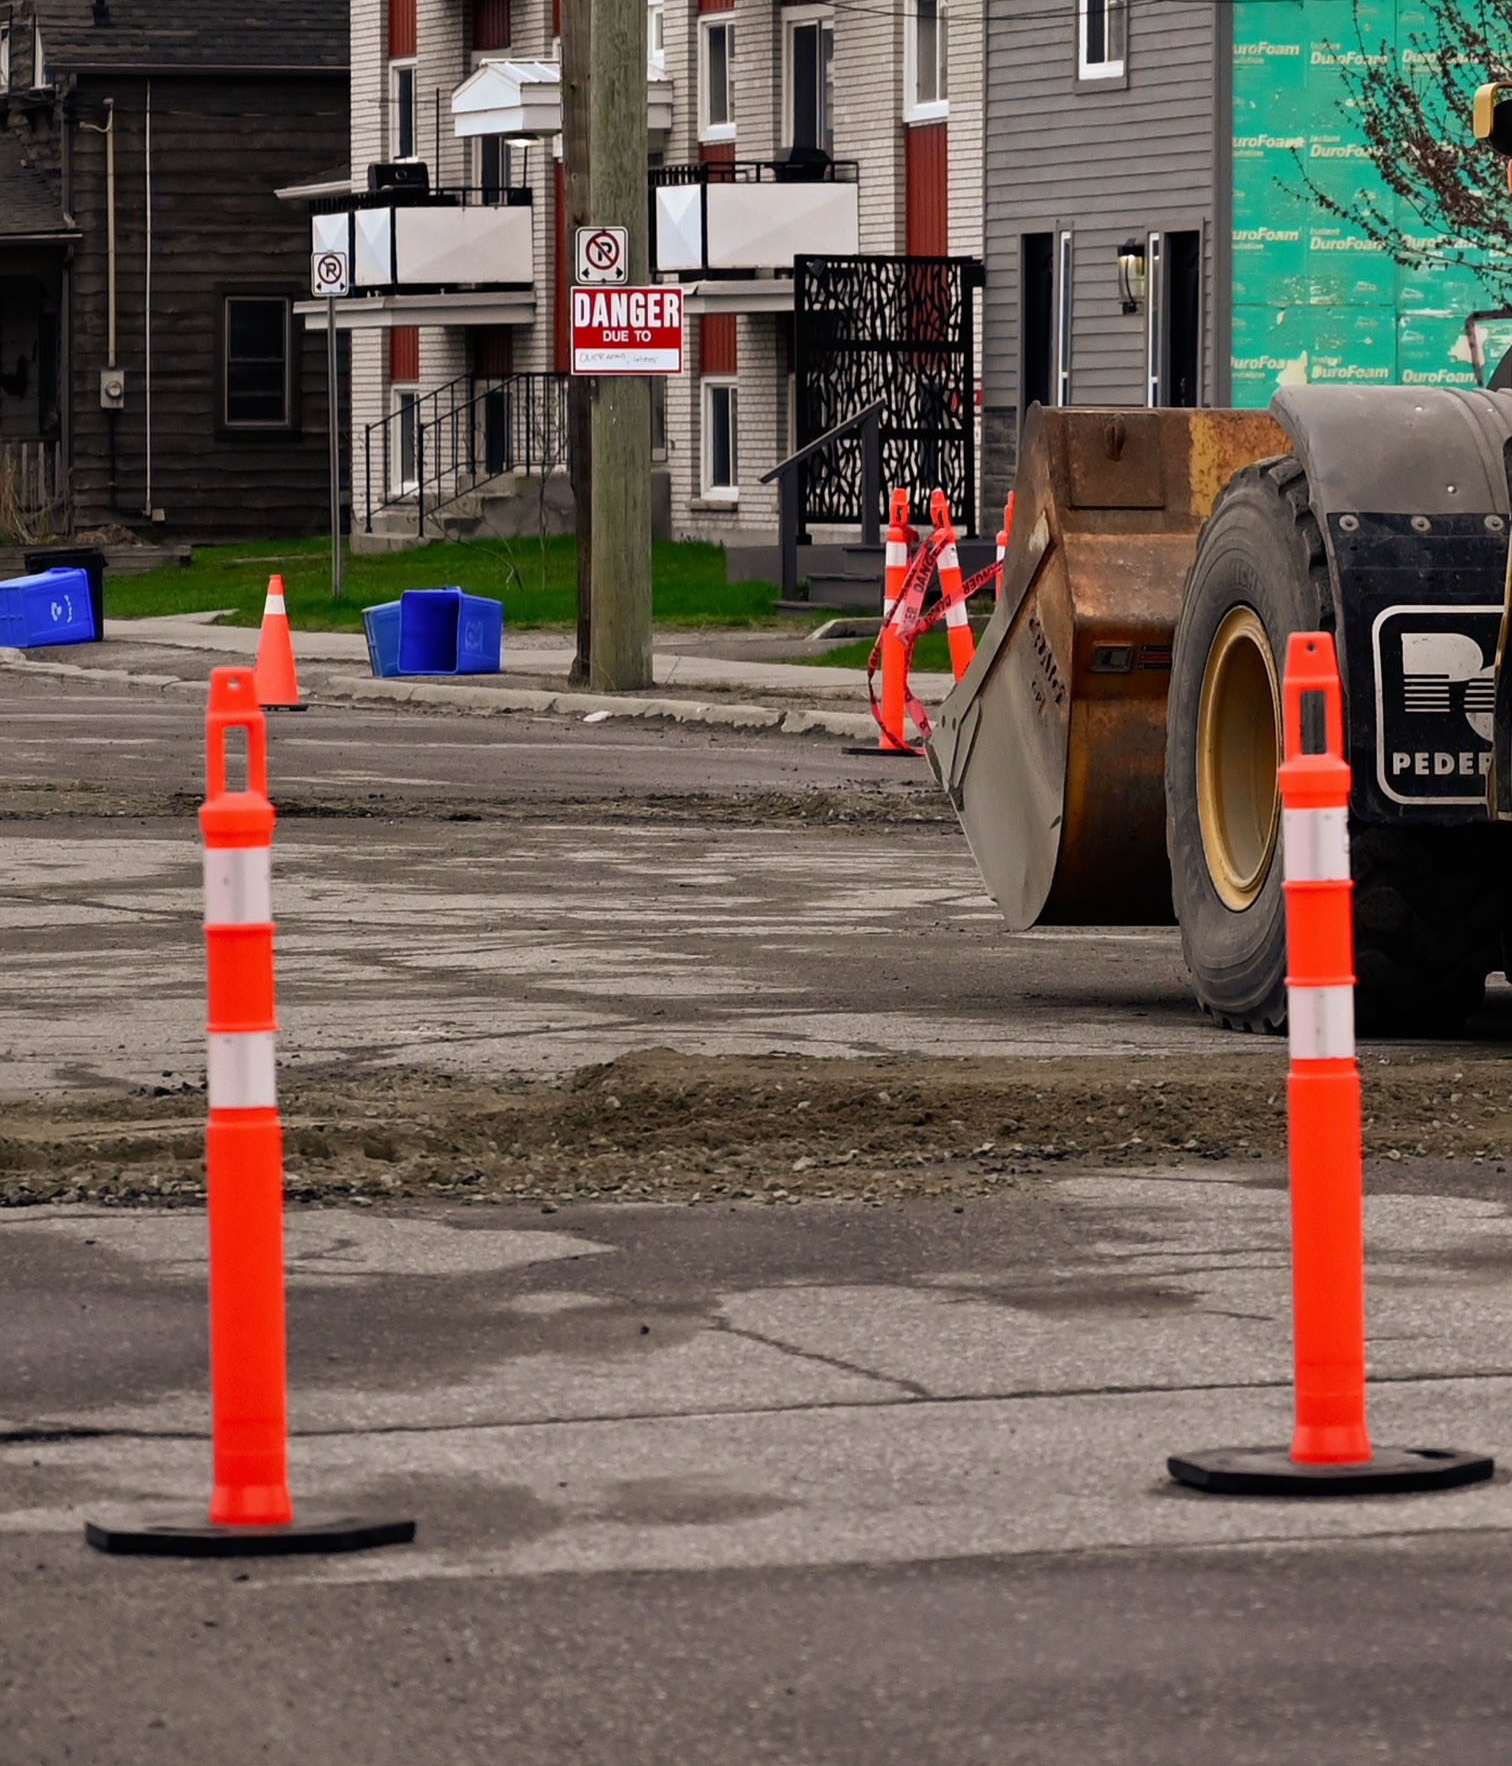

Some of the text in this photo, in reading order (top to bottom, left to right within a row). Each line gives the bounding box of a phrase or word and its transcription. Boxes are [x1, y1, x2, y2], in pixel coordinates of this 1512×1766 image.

[574, 292, 680, 328] DANGER
[603, 330, 651, 342] DUE TO
